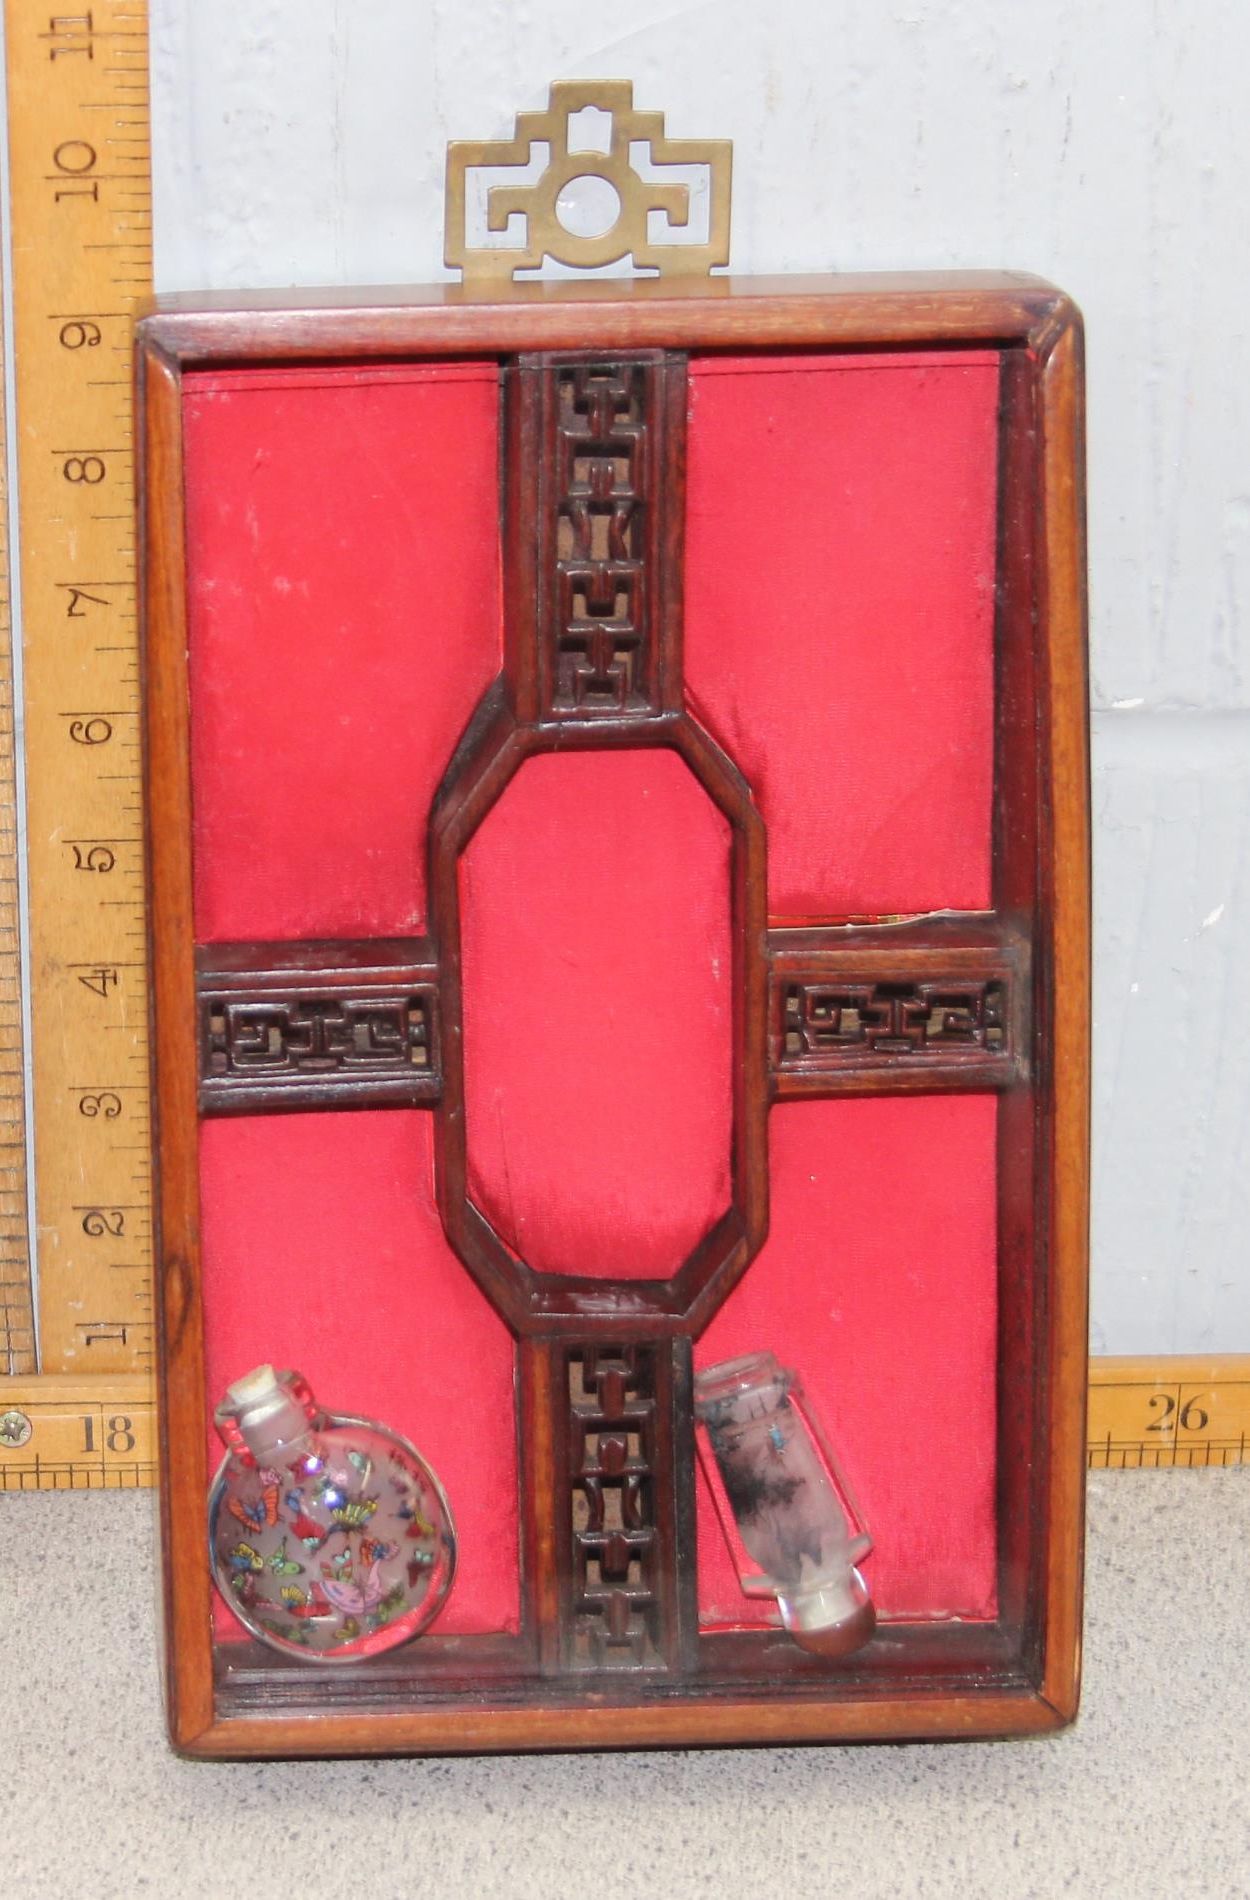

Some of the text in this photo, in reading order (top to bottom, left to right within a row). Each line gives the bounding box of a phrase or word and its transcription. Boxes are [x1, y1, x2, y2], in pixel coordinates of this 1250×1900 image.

[49, 10, 93, 61] 11
[53, 140, 98, 203] 10
[59, 321, 101, 350] 9
[63, 456, 106, 484] 8
[67, 588, 112, 617] 7
[69, 719, 112, 745] 6
[72, 846, 115, 873] 5
[78, 969, 117, 998] 4
[79, 1092, 122, 1118] 3
[82, 1212, 125, 1237] 2
[86, 1328, 127, 1346] 1
[1145, 1394, 1208, 1431] 26
[78, 1415, 136, 1453] 18
